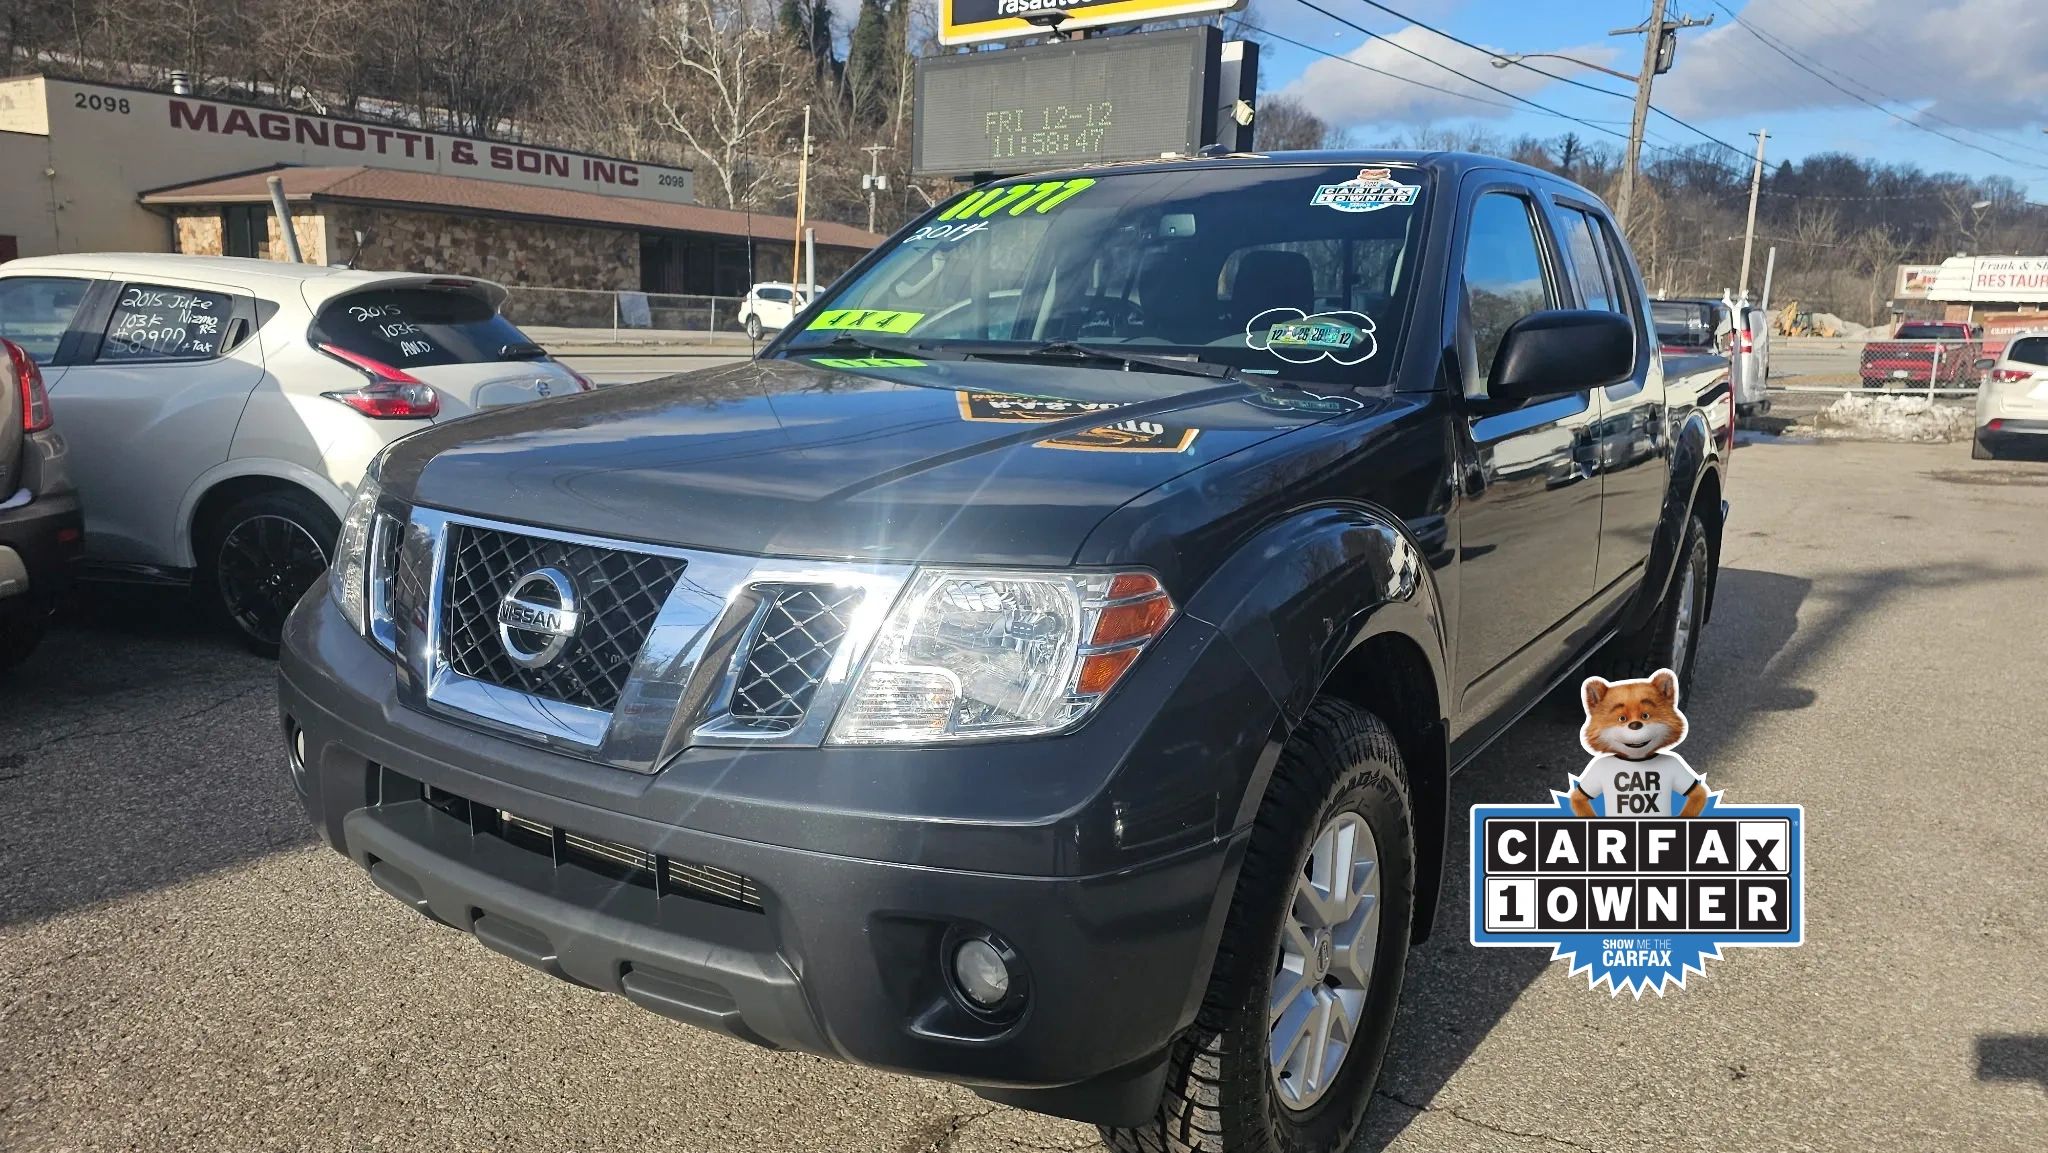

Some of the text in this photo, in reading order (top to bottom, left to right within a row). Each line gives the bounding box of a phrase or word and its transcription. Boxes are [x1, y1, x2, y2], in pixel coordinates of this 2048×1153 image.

[74, 93, 131, 115] 2098
[985, 101, 1113, 134] FRI 12-12
[169, 100, 639, 187] MAGNOTTI & SON INC
[993, 128, 1104, 158] 11:58:47
[658, 174, 685, 188] 2098
[1322, 187, 1411, 195] CARFAX
[902, 221, 989, 244] 2014
[1980, 261, 2015, 270] Frank
[2019, 261, 2030, 270] &
[122, 289, 213, 310] 2015 Juke
[348, 304, 401, 322] 2015
[199, 323, 217, 335] RS
[1339, 332, 1352, 345] 12
[192, 340, 213, 352] Tax
[500, 602, 562, 630] NISSAN
